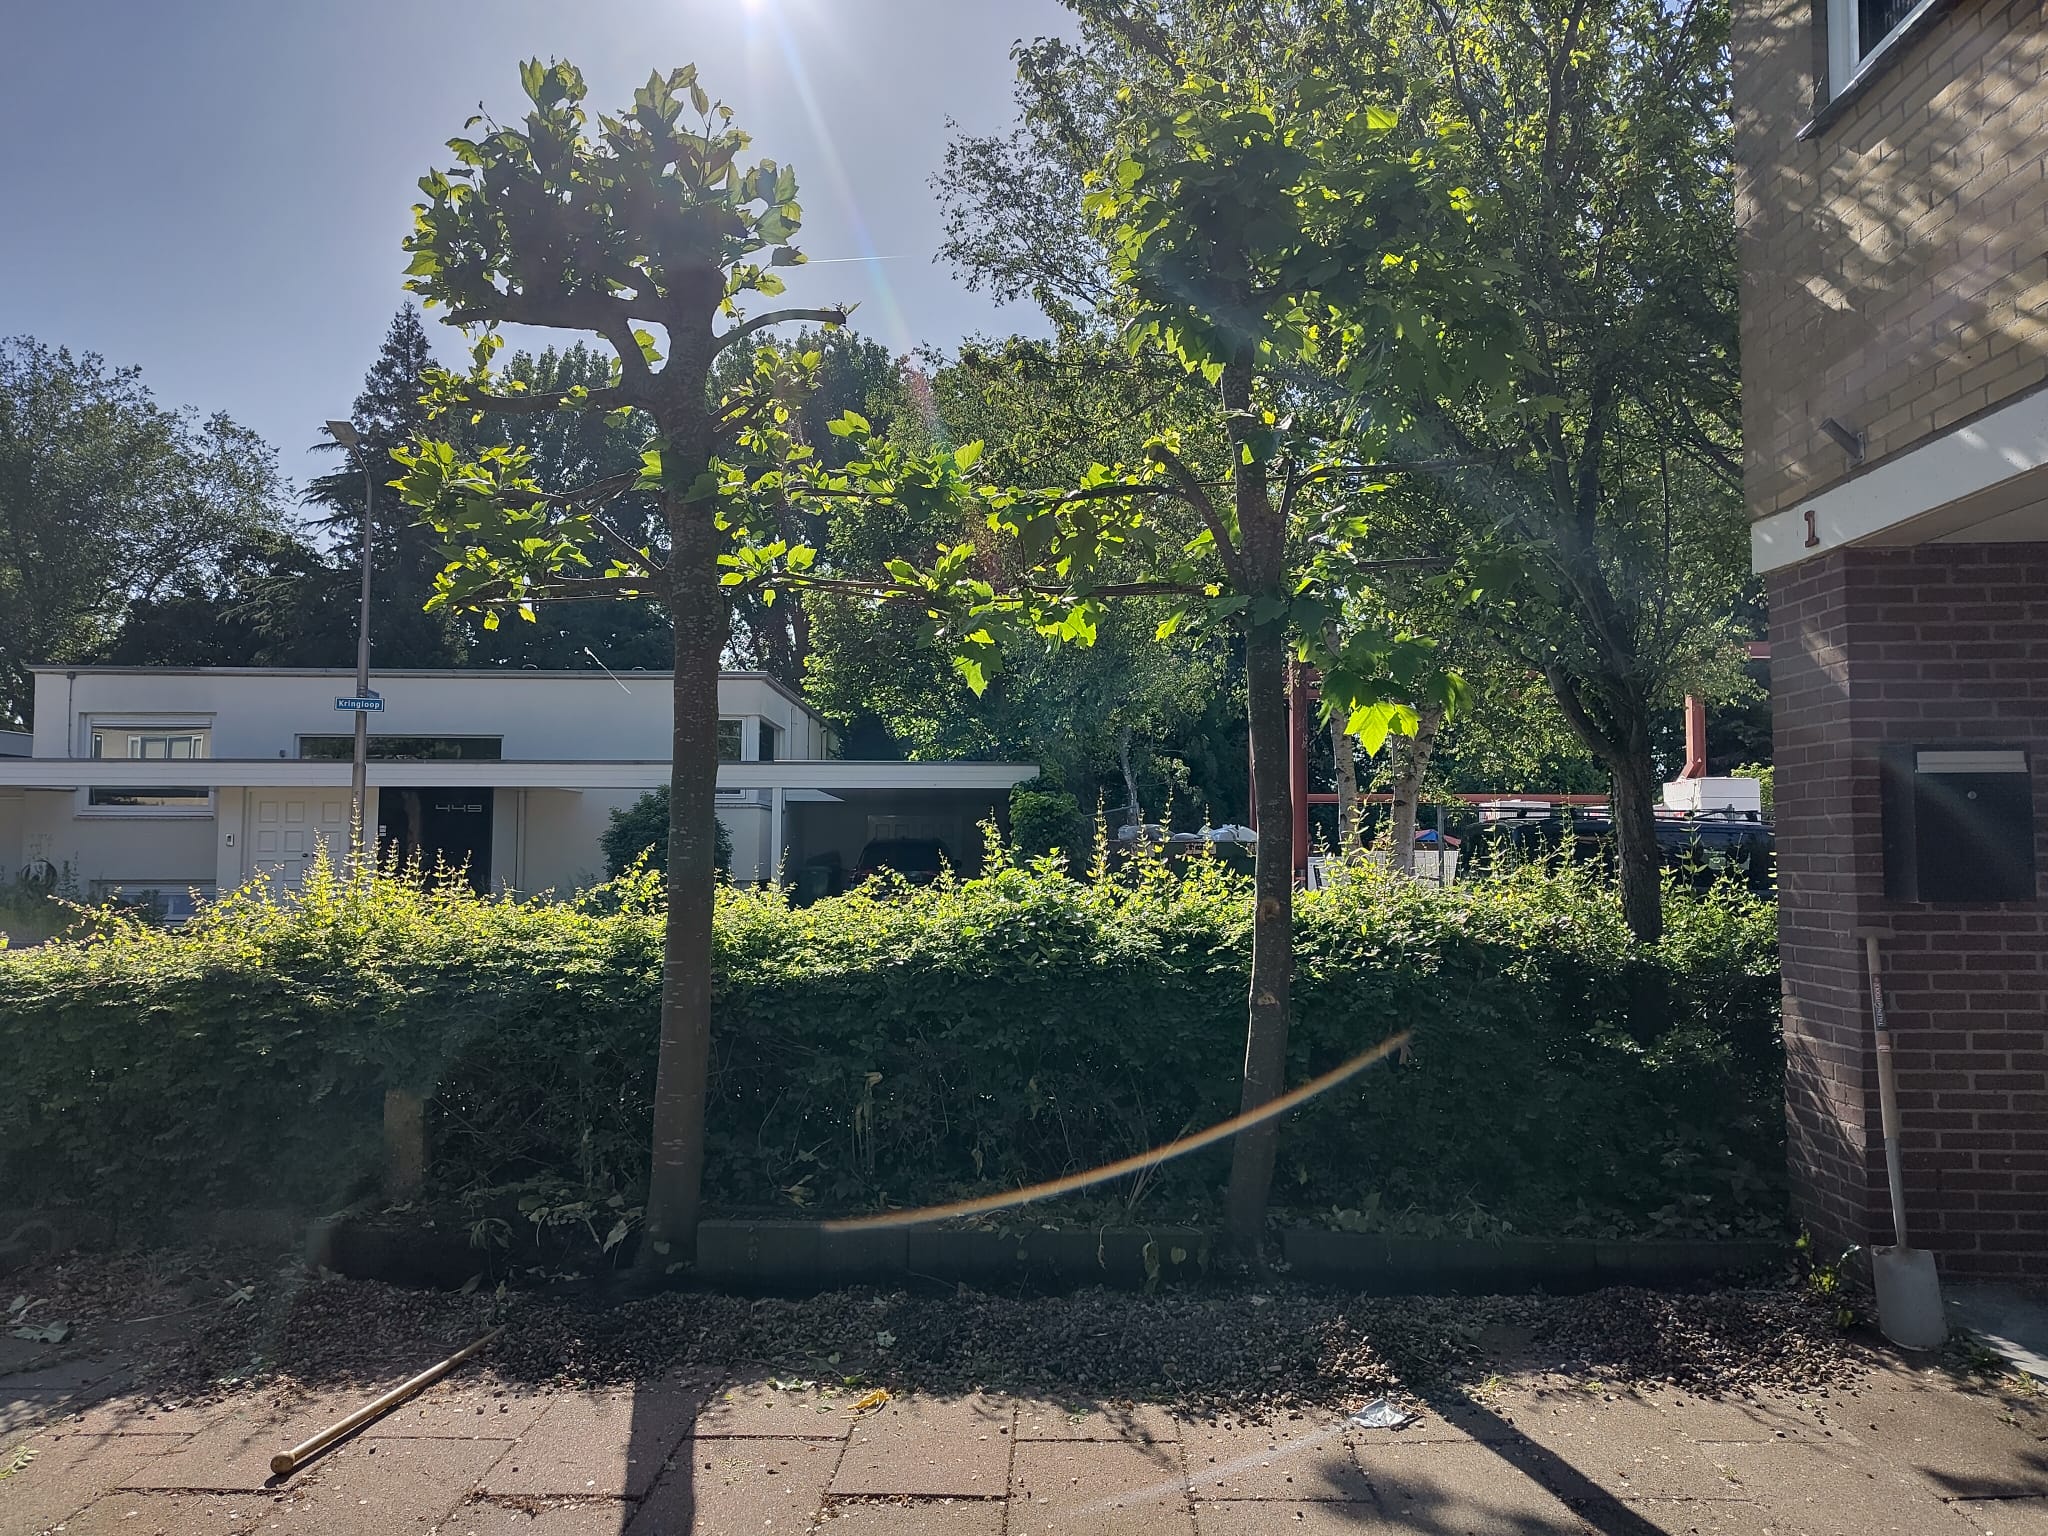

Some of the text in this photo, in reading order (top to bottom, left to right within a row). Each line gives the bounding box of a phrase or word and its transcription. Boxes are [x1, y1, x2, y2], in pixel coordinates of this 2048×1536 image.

[1804, 510, 1820, 548] 1
[338, 700, 380, 709] Kringloop
[435, 804, 482, 812] 449
